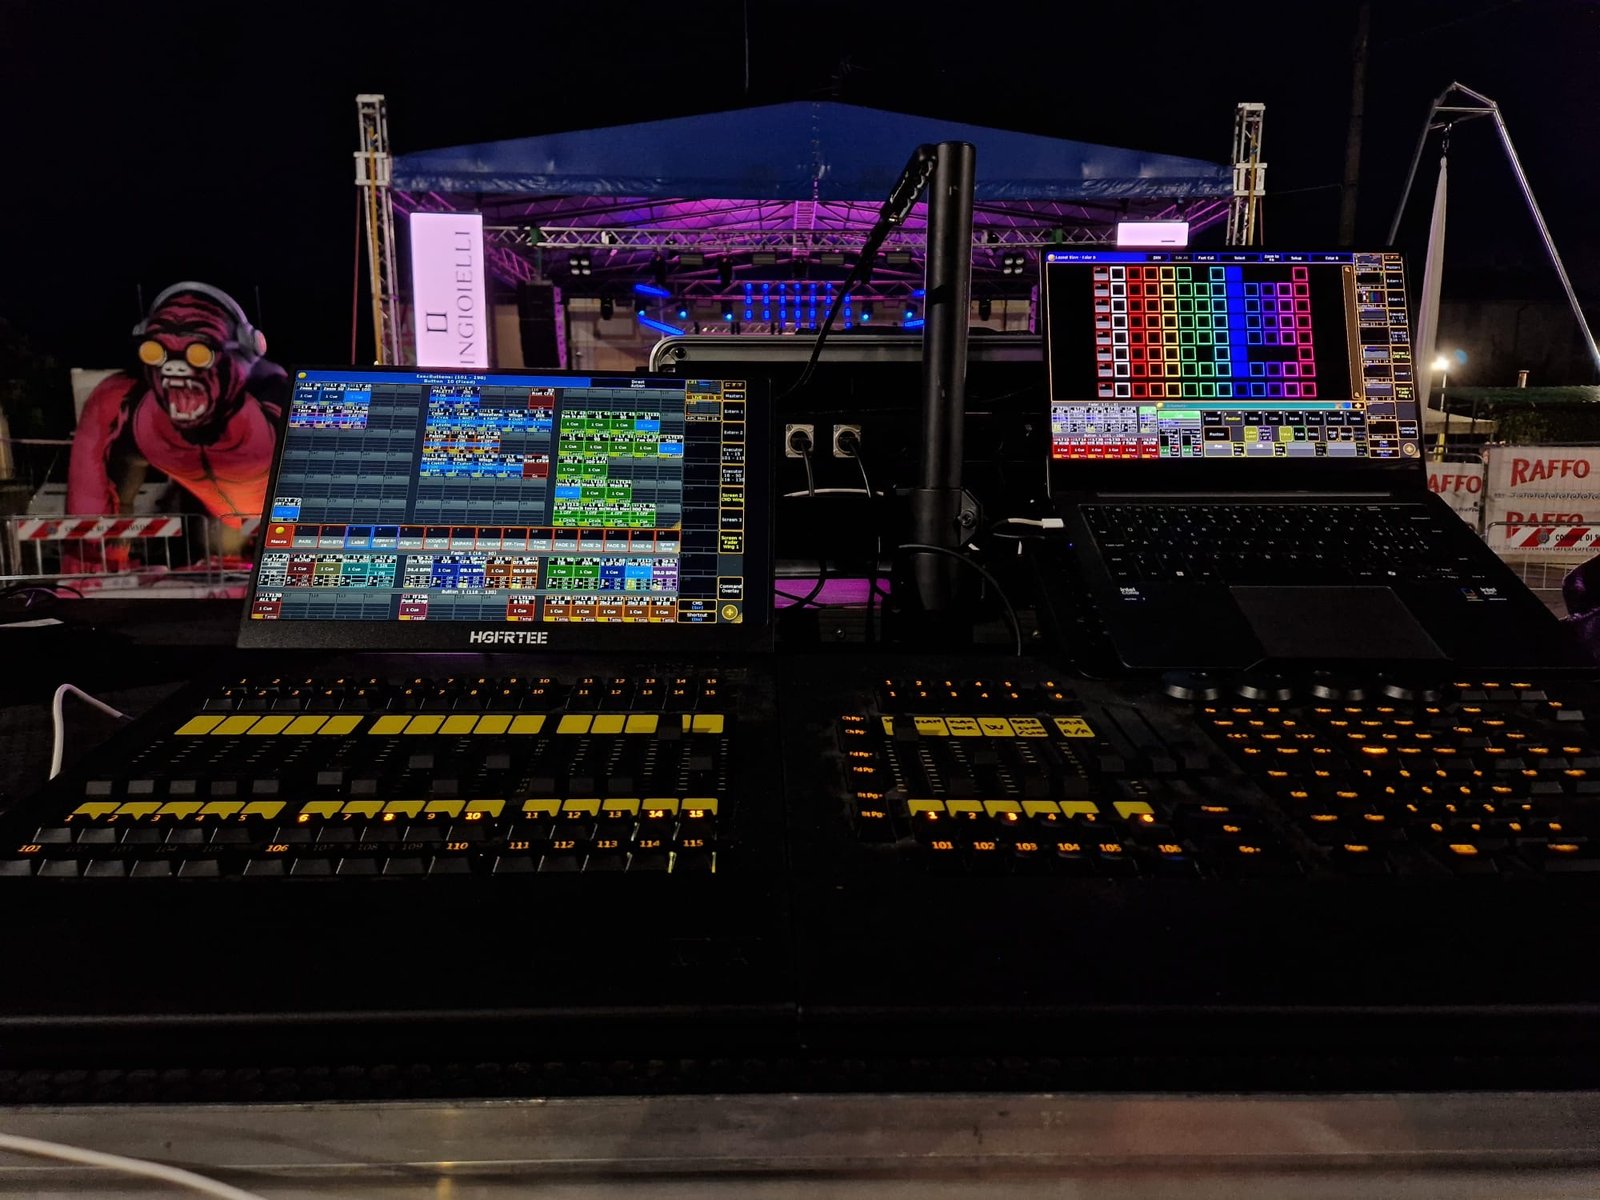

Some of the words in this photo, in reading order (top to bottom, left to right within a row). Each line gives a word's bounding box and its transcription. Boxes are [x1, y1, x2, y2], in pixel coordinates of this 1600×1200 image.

[1510, 458, 1590, 487] RAFFO
[1428, 474, 1482, 493] AFFO
[469, 631, 549, 644] HGFRTEE
[298, 813, 309, 822] 6
[384, 813, 395, 821] 8
[465, 812, 481, 820] 10
[525, 811, 538, 819] 11
[649, 810, 663, 818] 14
[689, 810, 703, 818] 15
[928, 812, 938, 820] 1
[1008, 813, 1017, 821] 3
[1048, 813, 1056, 821] 4
[1087, 813, 1095, 821] 5
[265, 844, 289, 853] 106
[446, 841, 469, 851] 110
[509, 841, 530, 850] 111
[553, 840, 575, 849] 112
[597, 840, 618, 849] 113
[639, 839, 660, 848] 114
[683, 839, 704, 848] 115
[931, 840, 954, 850] 101
[973, 841, 996, 851] 102
[1015, 842, 1038, 852] 103
[1057, 842, 1081, 852] 104
[1098, 843, 1122, 853] 105
[1158, 844, 1182, 854] 106
